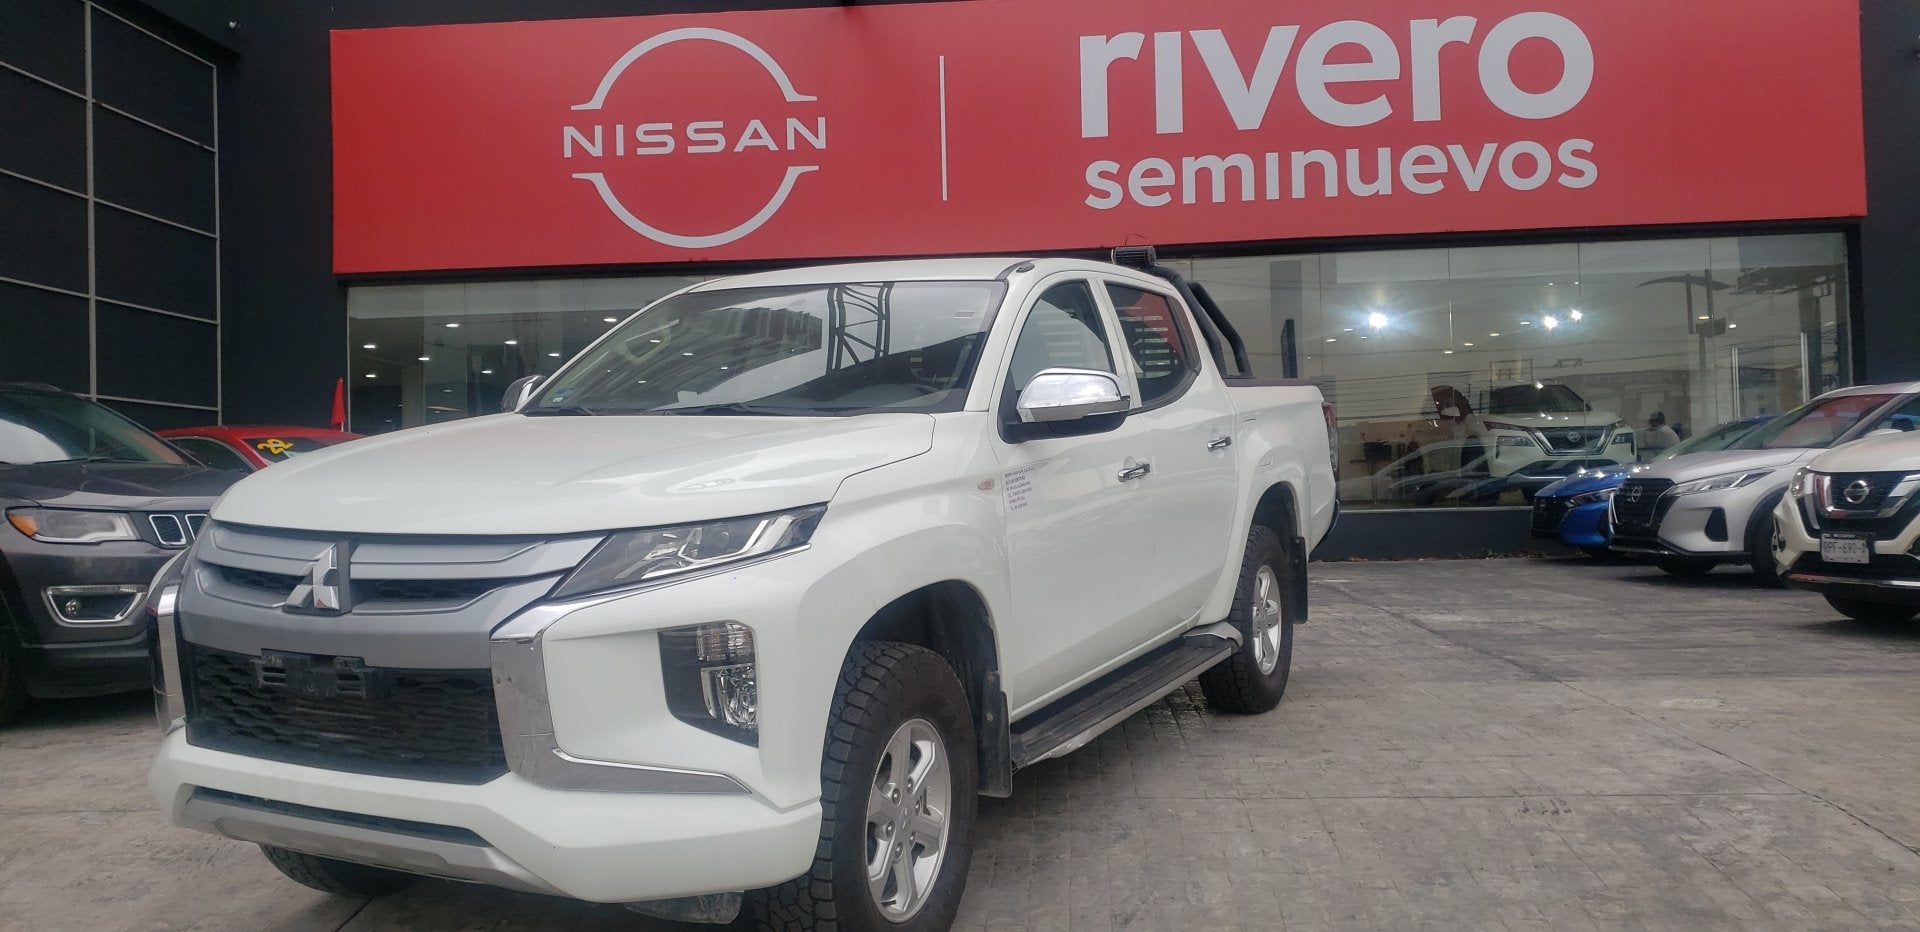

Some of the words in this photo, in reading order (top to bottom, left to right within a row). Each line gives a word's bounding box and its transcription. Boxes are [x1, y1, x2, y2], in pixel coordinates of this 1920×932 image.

[1080, 12, 1595, 138] rivero
[563, 116, 827, 158] NISSAN
[1085, 139, 1598, 210] seminuevos
